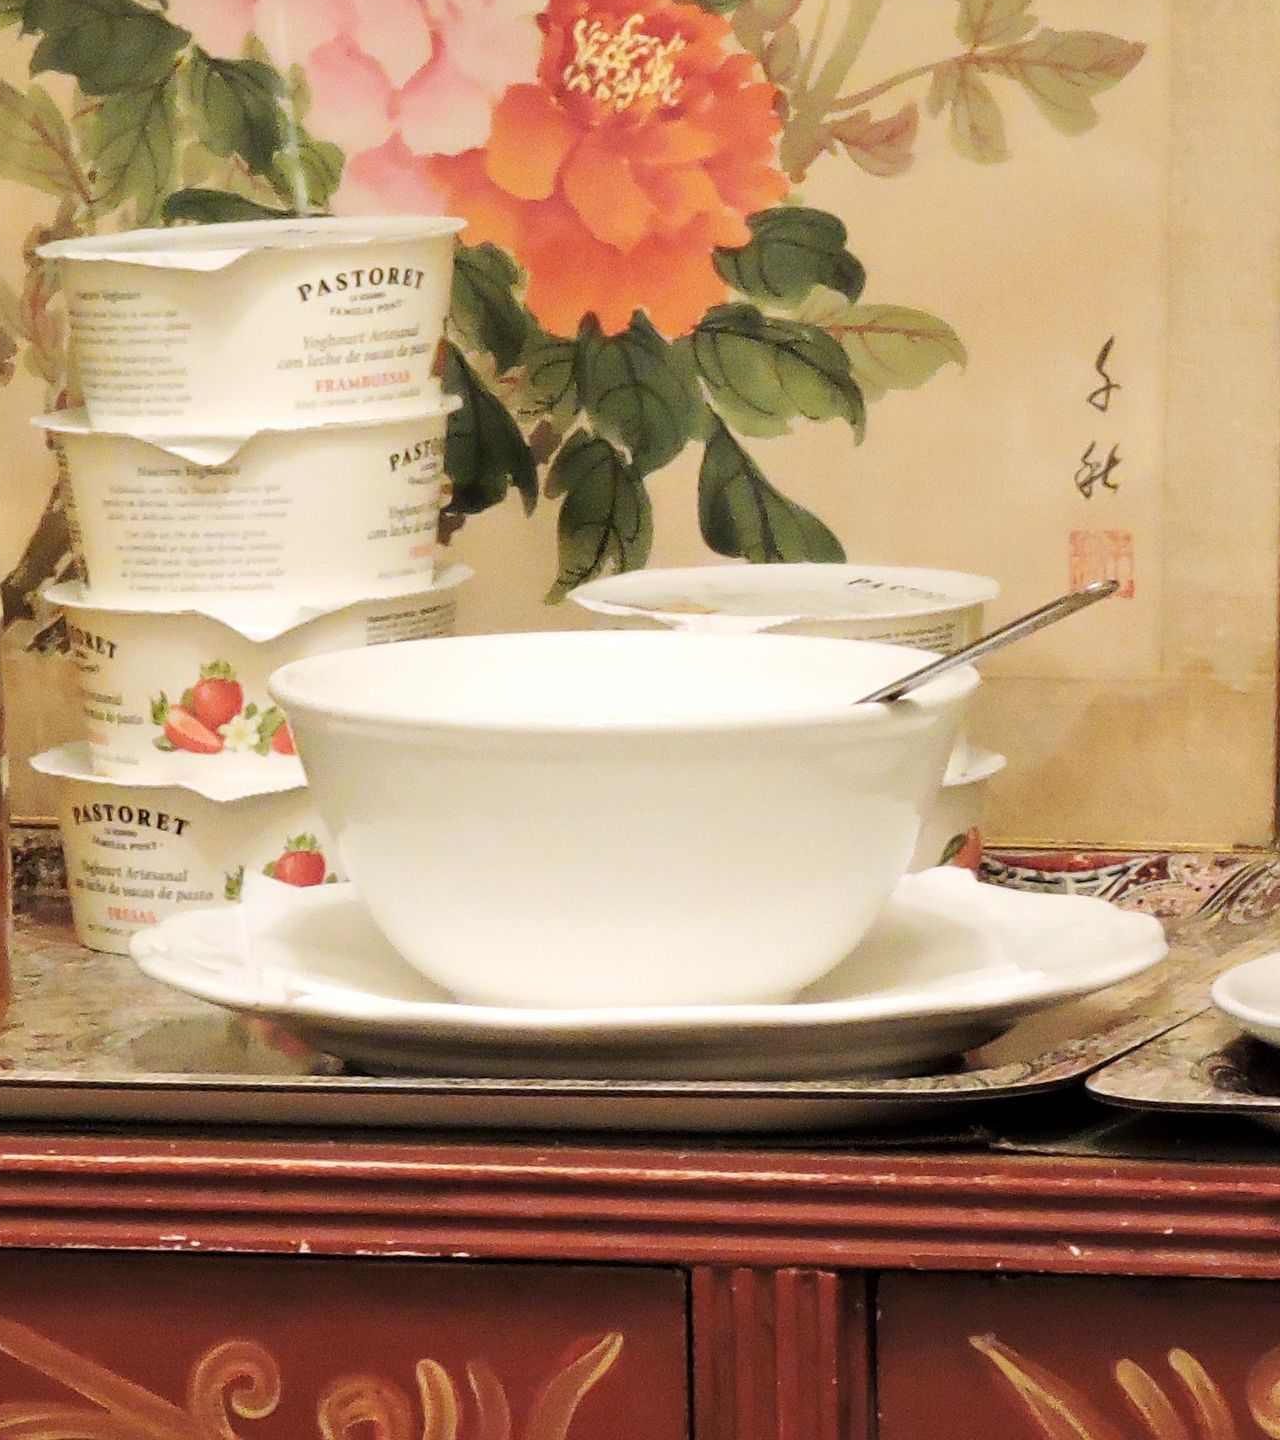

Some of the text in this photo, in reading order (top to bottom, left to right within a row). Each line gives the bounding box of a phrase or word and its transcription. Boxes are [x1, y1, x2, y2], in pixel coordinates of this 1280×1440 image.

[296, 266, 426, 303] PASTORET
[345, 349, 361, 364] de
[72, 803, 191, 836] PASTORET
[126, 866, 188, 883] Artesanal
[158, 886, 174, 900] de
[176, 889, 214, 904] pasto
